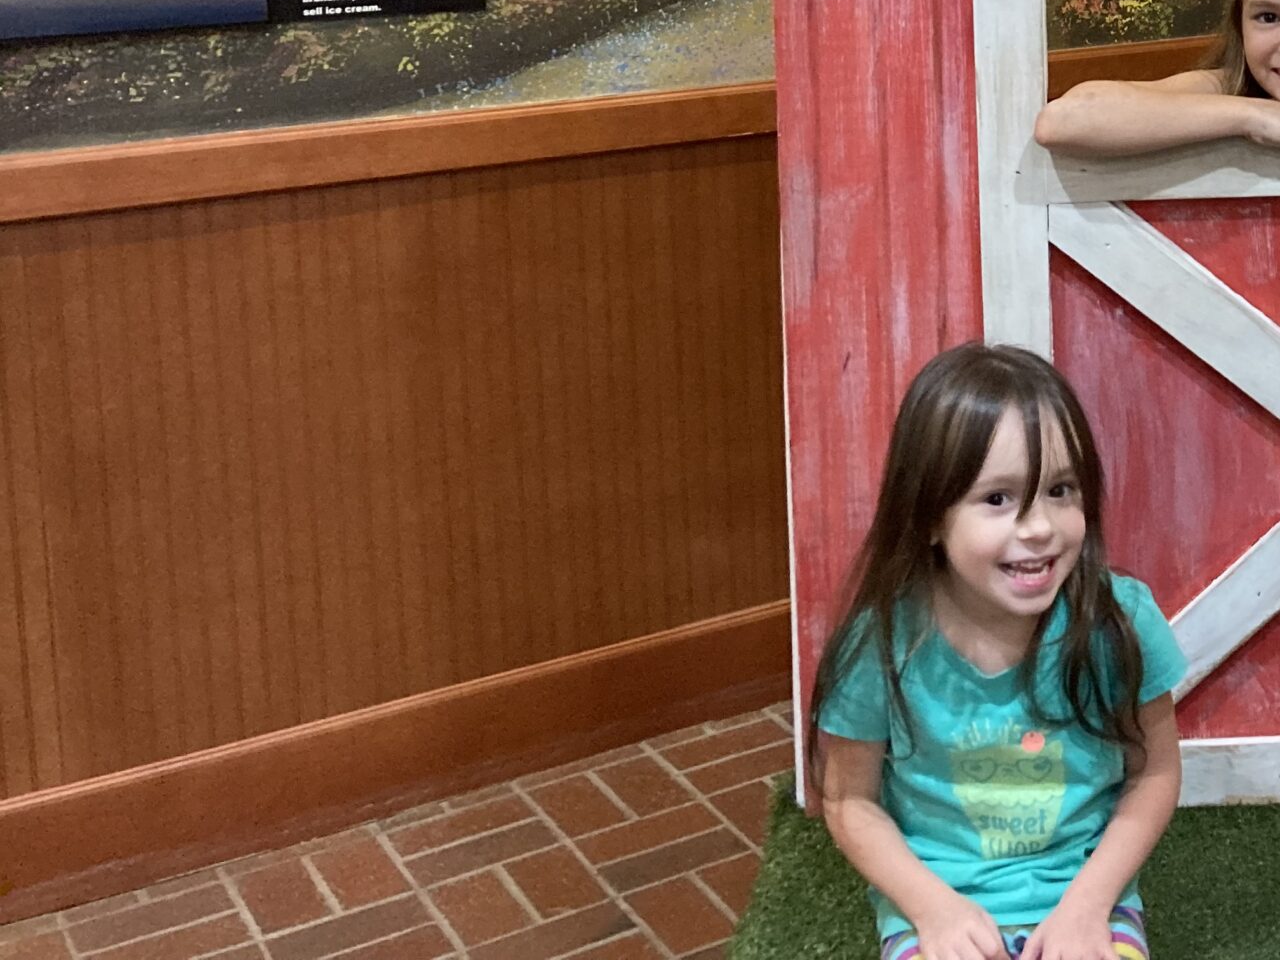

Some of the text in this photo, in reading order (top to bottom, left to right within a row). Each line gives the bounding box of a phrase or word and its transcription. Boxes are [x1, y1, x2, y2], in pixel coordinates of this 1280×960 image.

[303, 3, 382, 17] sell ice cream.
[979, 808, 1048, 836] sweet
